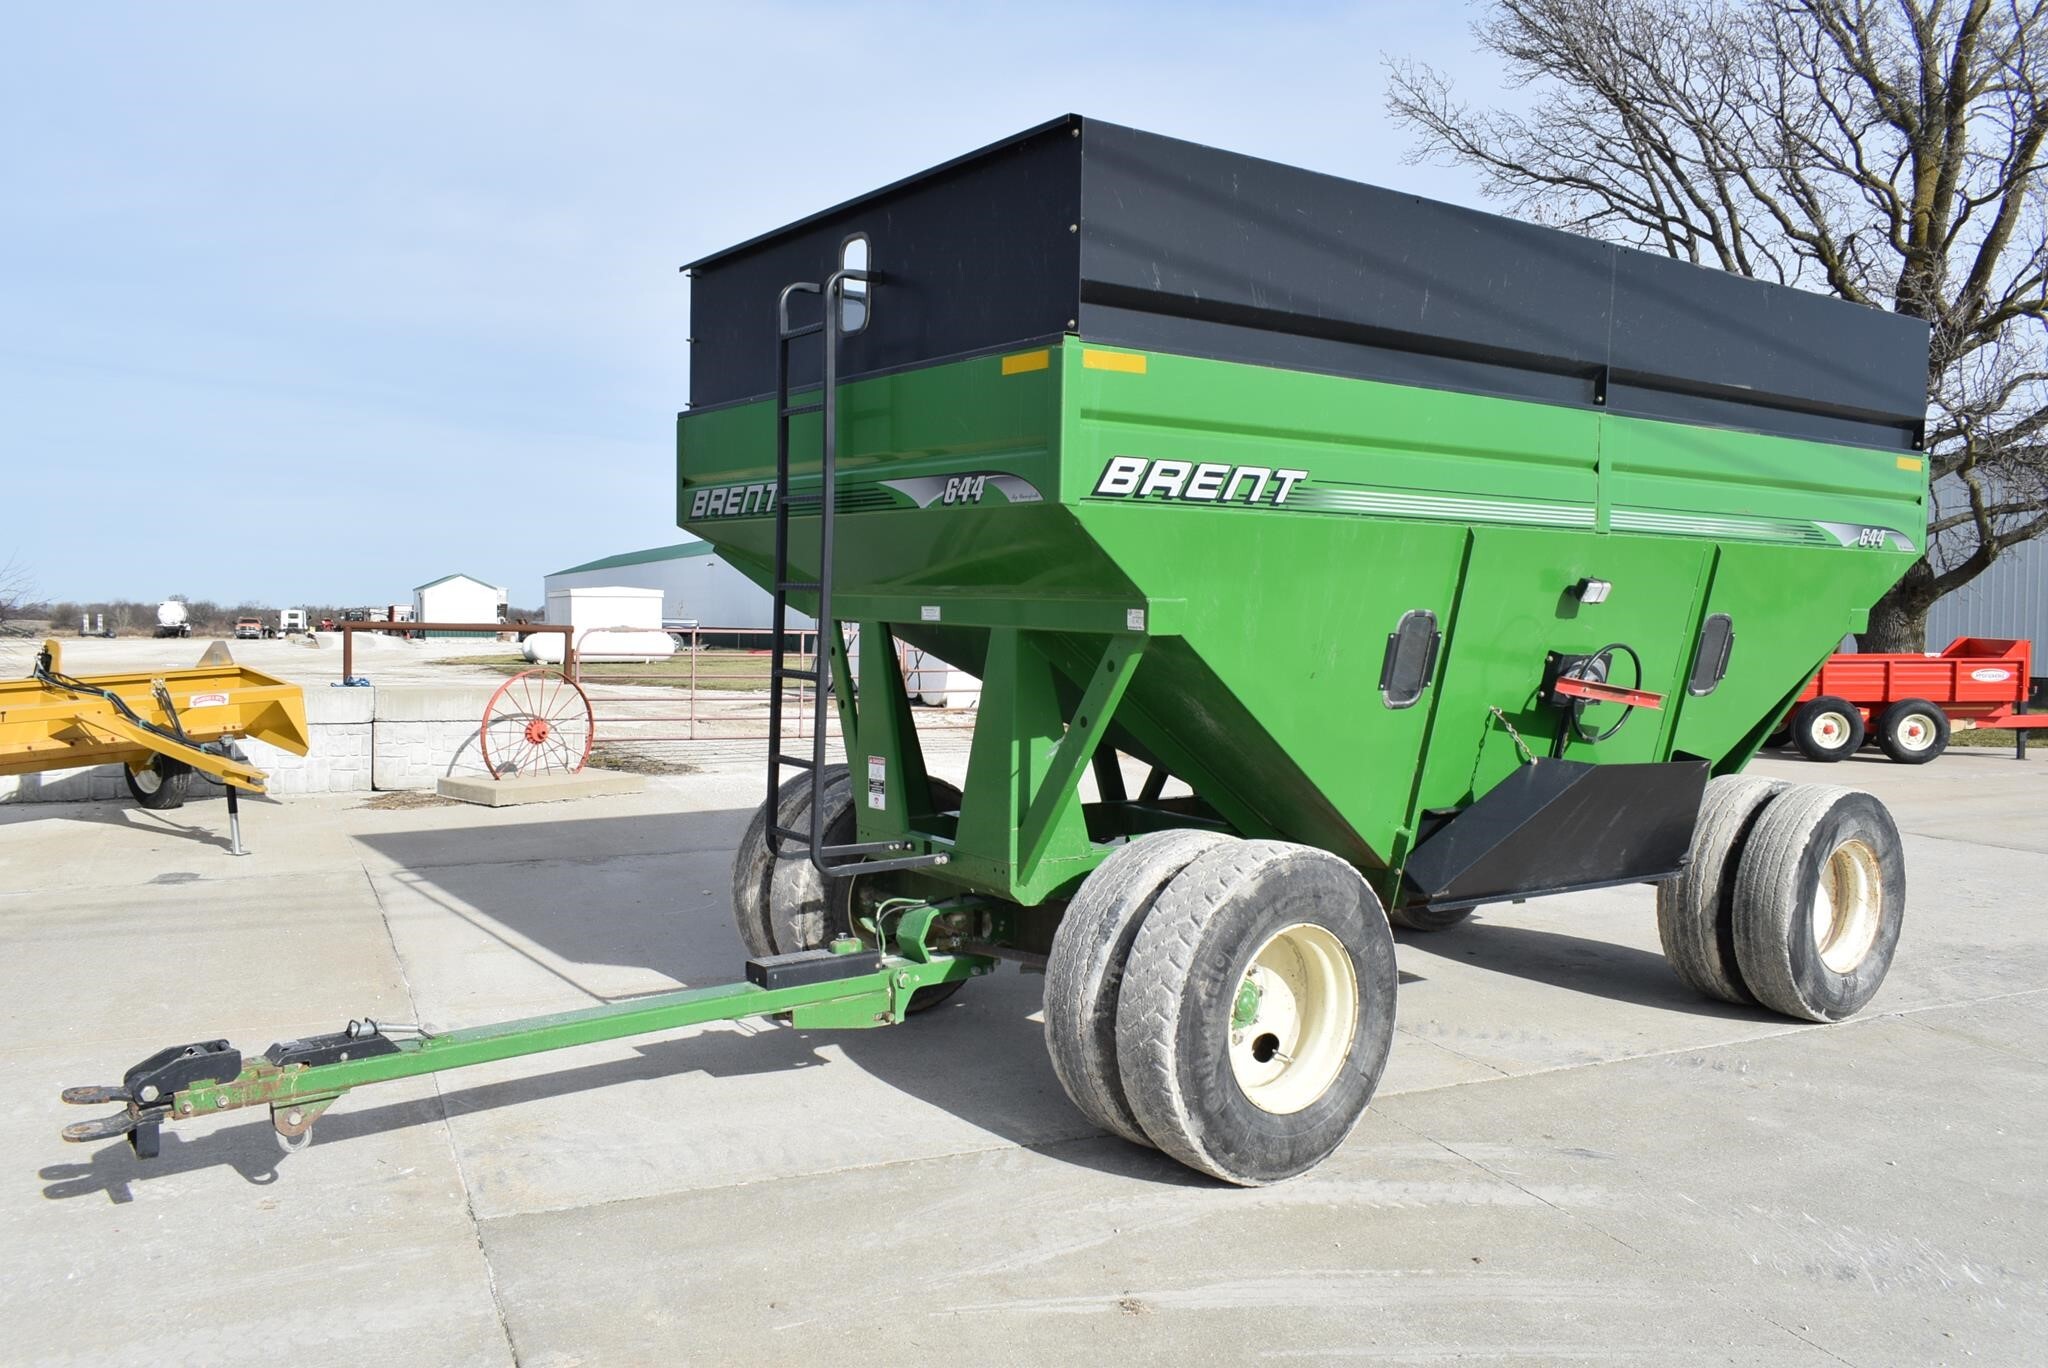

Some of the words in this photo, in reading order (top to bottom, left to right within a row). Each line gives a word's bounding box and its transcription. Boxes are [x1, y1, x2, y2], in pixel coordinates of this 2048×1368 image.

[943, 475, 985, 504] 644
[1092, 456, 1309, 505] BRENT
[690, 484, 777, 517] BRENT
[1859, 528, 1885, 547] 644
